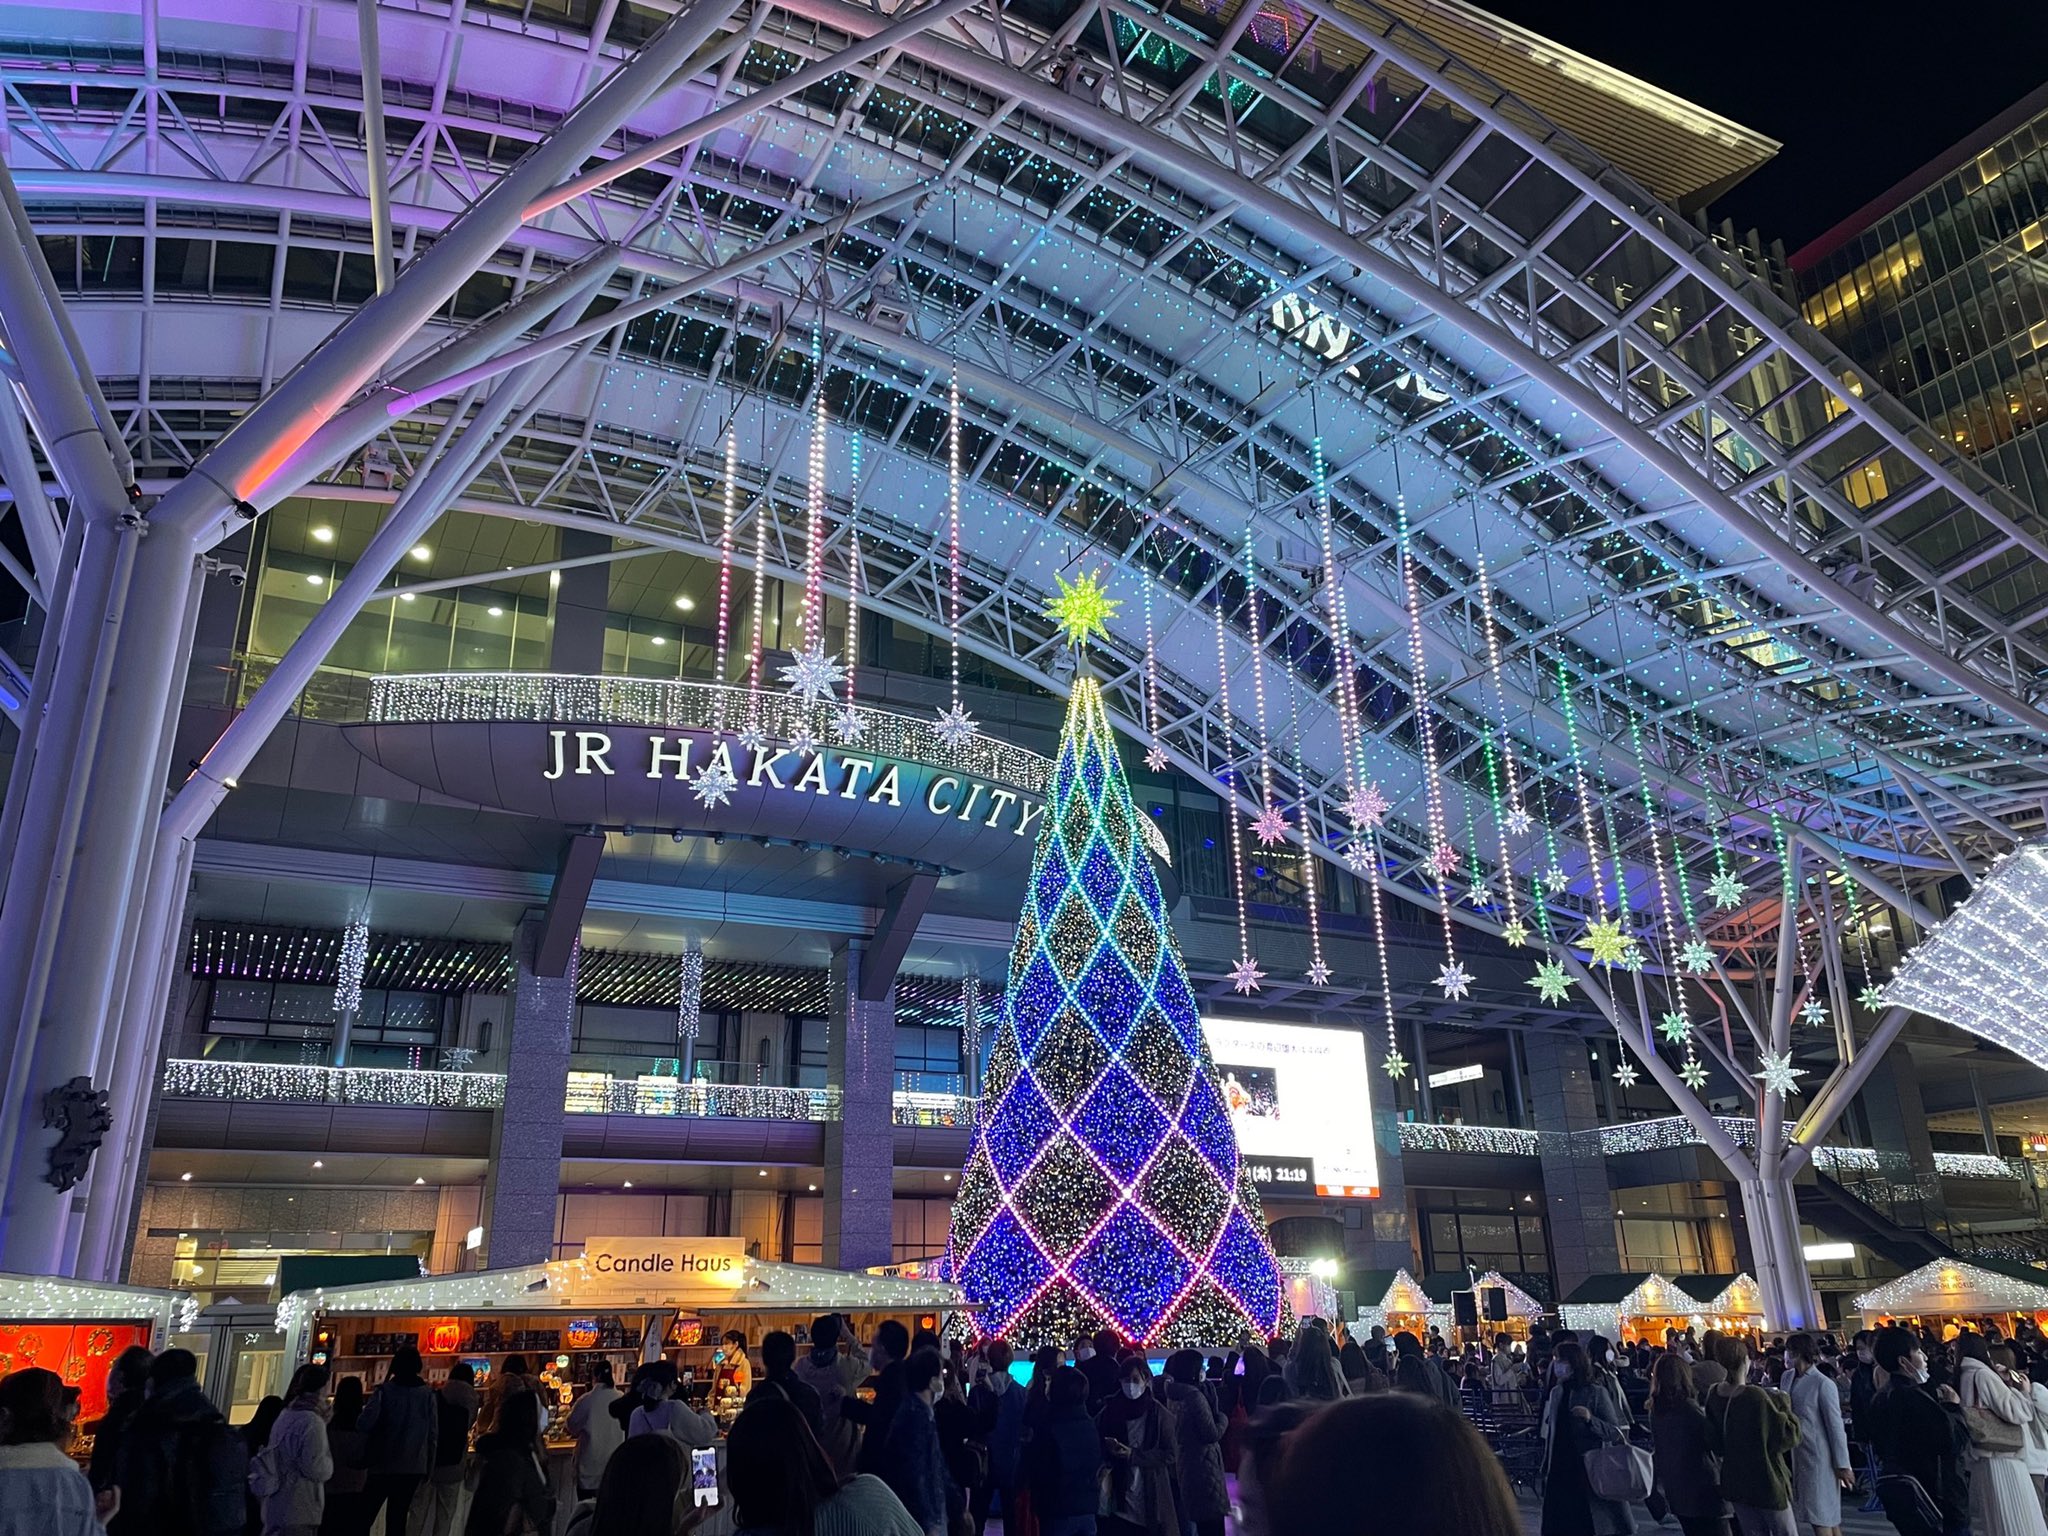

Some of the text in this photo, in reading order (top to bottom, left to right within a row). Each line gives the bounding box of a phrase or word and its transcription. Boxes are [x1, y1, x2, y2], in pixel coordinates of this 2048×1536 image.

[543, 730, 1046, 836] JR HAKATA CITY
[596, 1253, 731, 1272] Candle Haus
